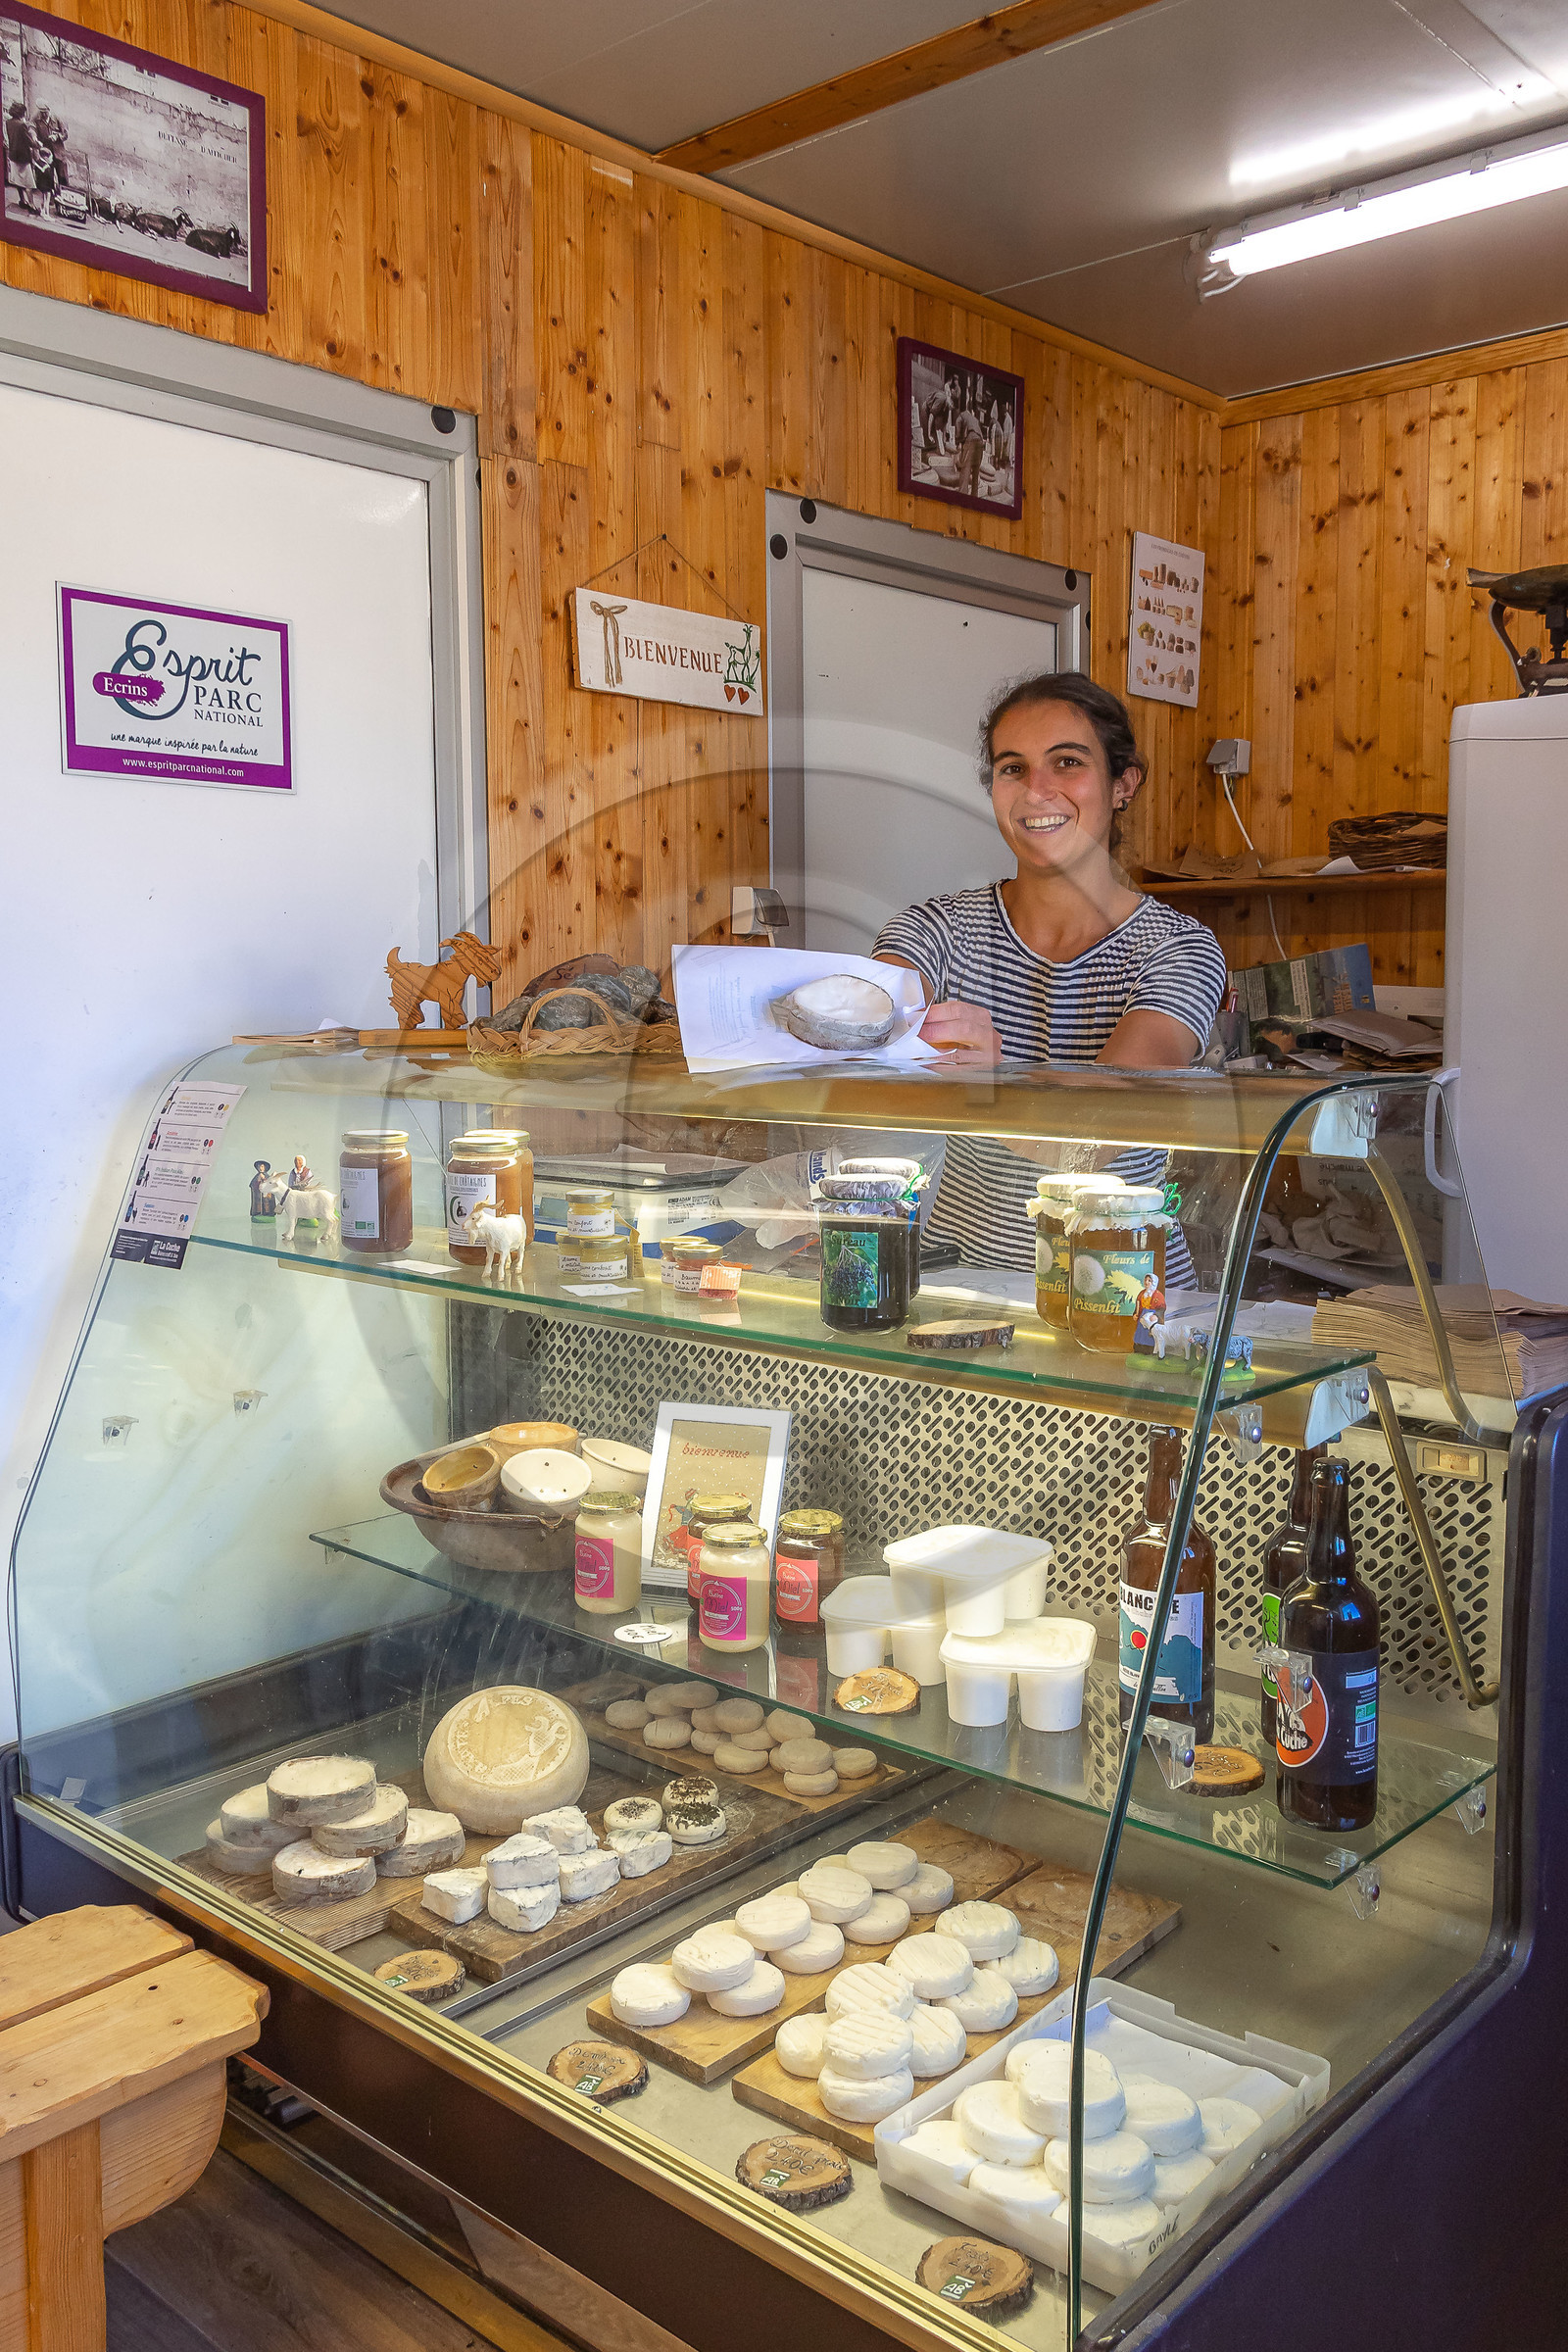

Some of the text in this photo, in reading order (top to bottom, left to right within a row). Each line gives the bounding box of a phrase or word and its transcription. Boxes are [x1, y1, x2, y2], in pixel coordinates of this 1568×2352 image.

[623, 636, 724, 674] BIENVENUE
[111, 619, 262, 720] Esprit
[102, 676, 148, 697] Ecrins
[193, 684, 262, 713] PARC
[193, 709, 264, 727] NATIONAL
[110, 733, 259, 757] une marque inspirée par la nature
[122, 758, 245, 778] www.espritparcnational.com
[831, 1232, 866, 1248] Sureau
[1052, 1236, 1071, 1248] Fleu
[1102, 1252, 1151, 1265] Fleurs de
[1073, 1297, 1121, 1314] Pissenlit
[682, 1442, 751, 1459] bienvenue
[1119, 1587, 1180, 1614] BLANCE
[943, 2282, 966, 2295] AB
